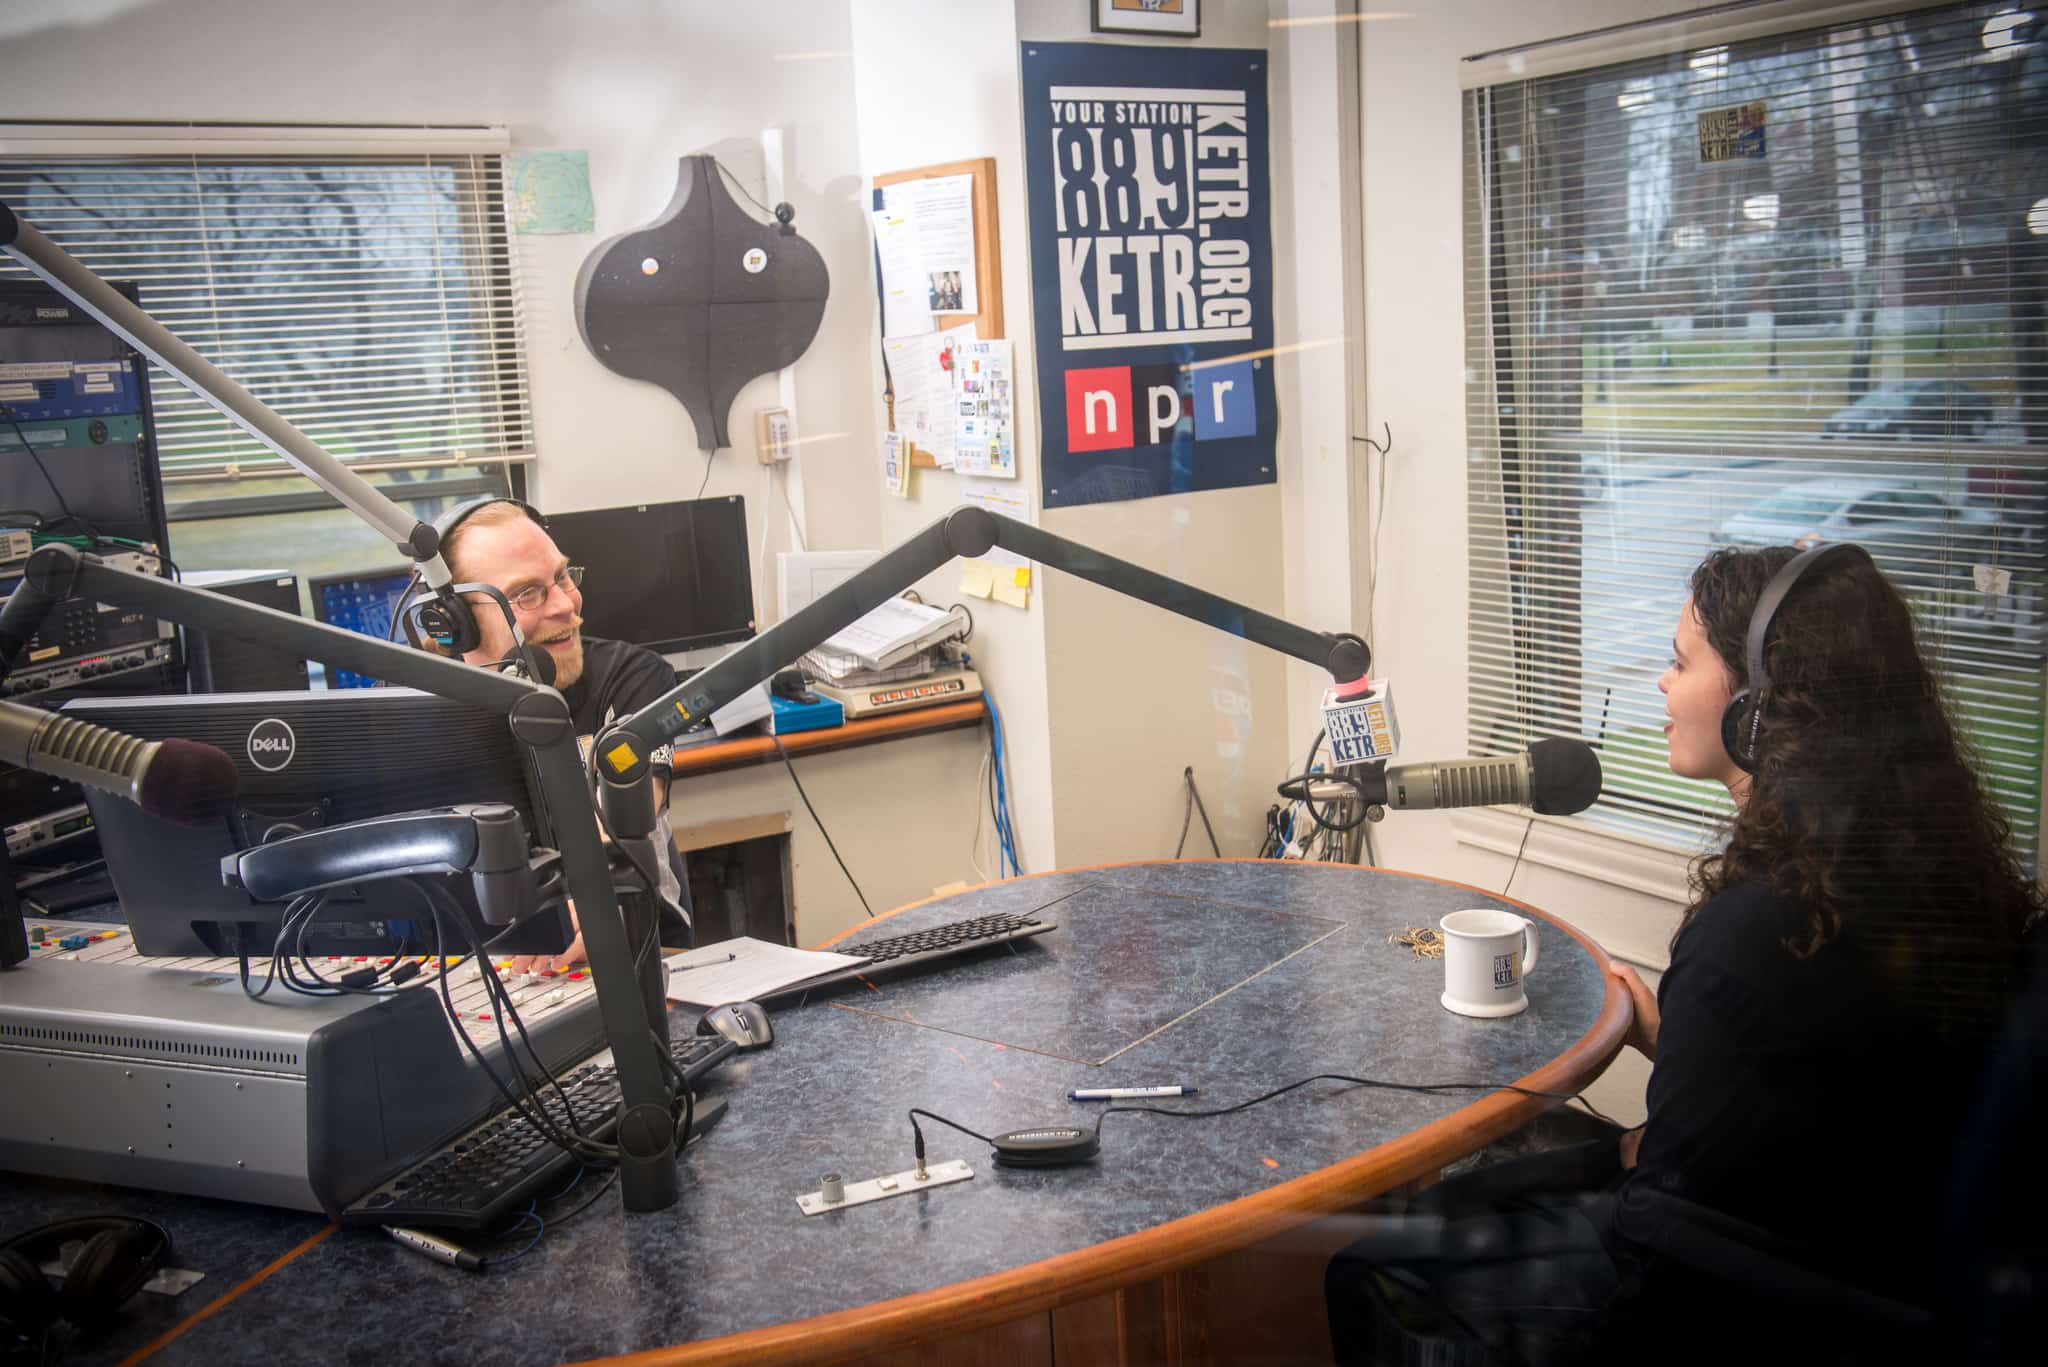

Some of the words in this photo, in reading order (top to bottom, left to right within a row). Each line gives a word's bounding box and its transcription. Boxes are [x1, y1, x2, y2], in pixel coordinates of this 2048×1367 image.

[1051, 102, 1105, 124] YOUR
[1115, 103, 1193, 124] STATION
[1054, 128, 1192, 231] 88.9
[1196, 104, 1253, 328] KETR.ORG
[1058, 234, 1199, 336] KETR
[1084, 380, 1234, 445] npr
[252, 737, 291, 752] DELL
[1333, 734, 1377, 761] KETR
